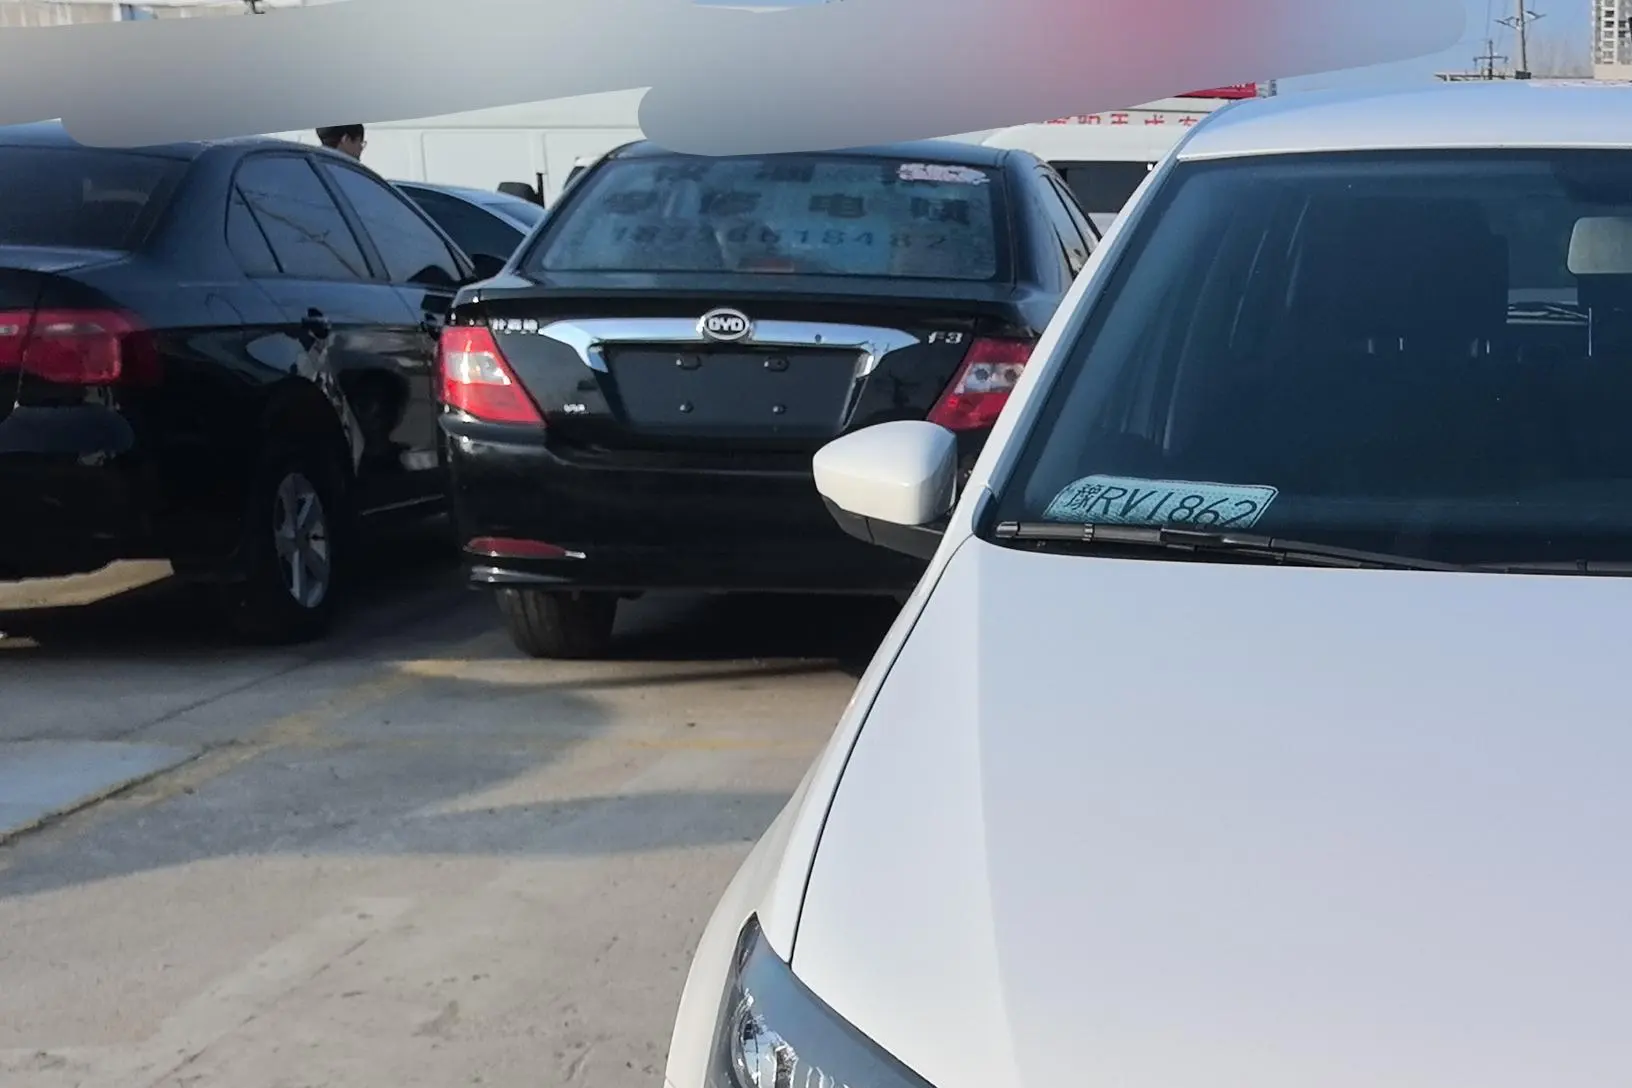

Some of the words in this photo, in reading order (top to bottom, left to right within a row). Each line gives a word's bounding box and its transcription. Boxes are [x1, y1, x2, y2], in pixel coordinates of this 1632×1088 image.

[709, 317, 743, 331] BYD
[928, 331, 963, 344] F3
[1064, 484, 1257, 528] 豫RV1862
